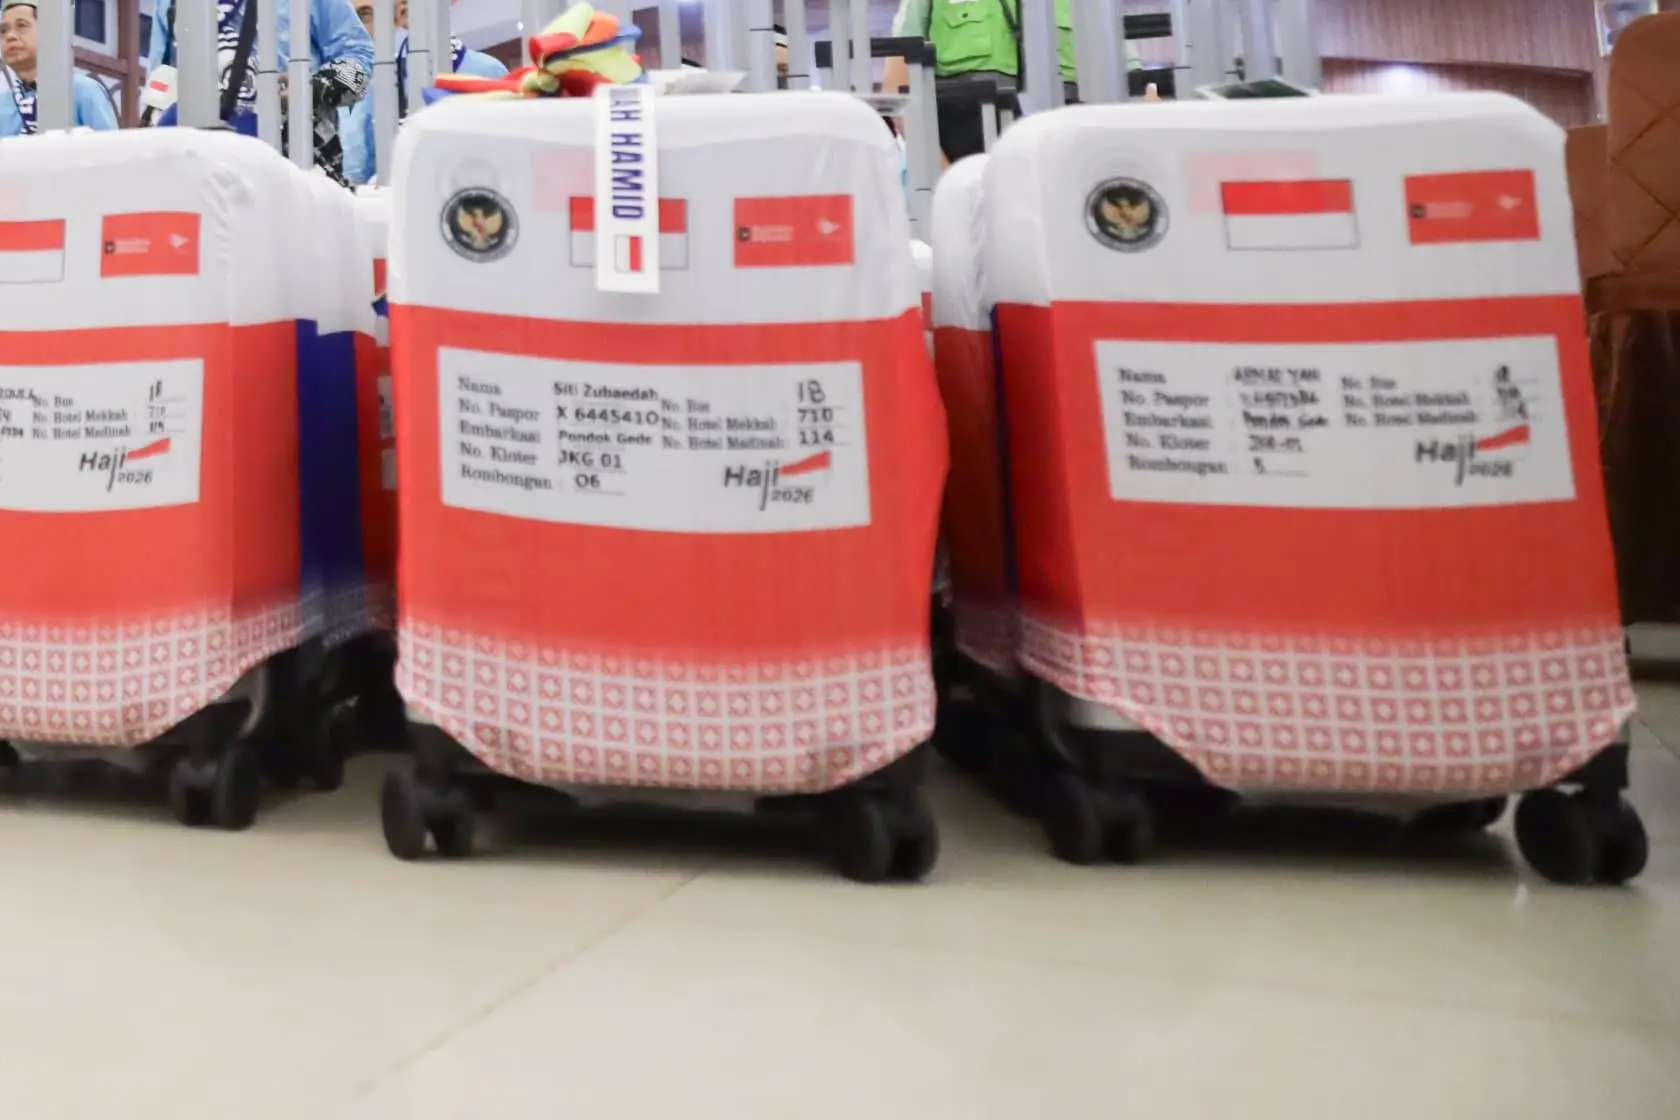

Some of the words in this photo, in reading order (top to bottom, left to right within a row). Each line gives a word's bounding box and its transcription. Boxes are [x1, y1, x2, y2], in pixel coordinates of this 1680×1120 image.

[611, 133, 644, 220] HAMID
[1118, 367, 1167, 384] Nama
[458, 376, 502, 396] Nama
[554, 381, 578, 397] Siti
[583, 384, 659, 401] Zubaedah
[54, 395, 73, 407] Bus
[687, 399, 710, 413] Bus
[1154, 391, 1209, 410] Paspor
[1372, 395, 1409, 407] Hotel
[1415, 392, 1471, 407] Mekkah
[53, 411, 81, 423] Hotel
[85, 409, 128, 423] Mekkah
[489, 402, 540, 423] Paspor
[556, 405, 568, 420] X
[798, 408, 833, 423] 710
[1124, 411, 1212, 429] Embarkasi
[1375, 413, 1411, 426] Hotel
[1416, 411, 1479, 425] Madinah
[459, 419, 540, 444] Embarkasi
[687, 418, 720, 431] Hotel
[726, 416, 777, 430] Mekkah
[53, 428, 81, 440] Hotel
[85, 425, 131, 439] Madinah
[558, 430, 611, 444] Pondok
[617, 432, 653, 445] Gede
[799, 429, 834, 445] 114
[688, 436, 720, 450] Hotel
[727, 435, 784, 450] Madinah
[1159, 433, 1210, 450] Kloter
[490, 445, 538, 465] Kloter
[558, 449, 594, 468] JKG
[1415, 434, 1476, 486] Haji
[79, 446, 128, 493] Haji
[117, 471, 153, 485] 2026
[1128, 454, 1228, 476] Rombongan
[460, 464, 552, 491] Rombongan
[575, 473, 600, 489] 06
[723, 459, 780, 511] Haji
[770, 488, 813, 504] 2026
